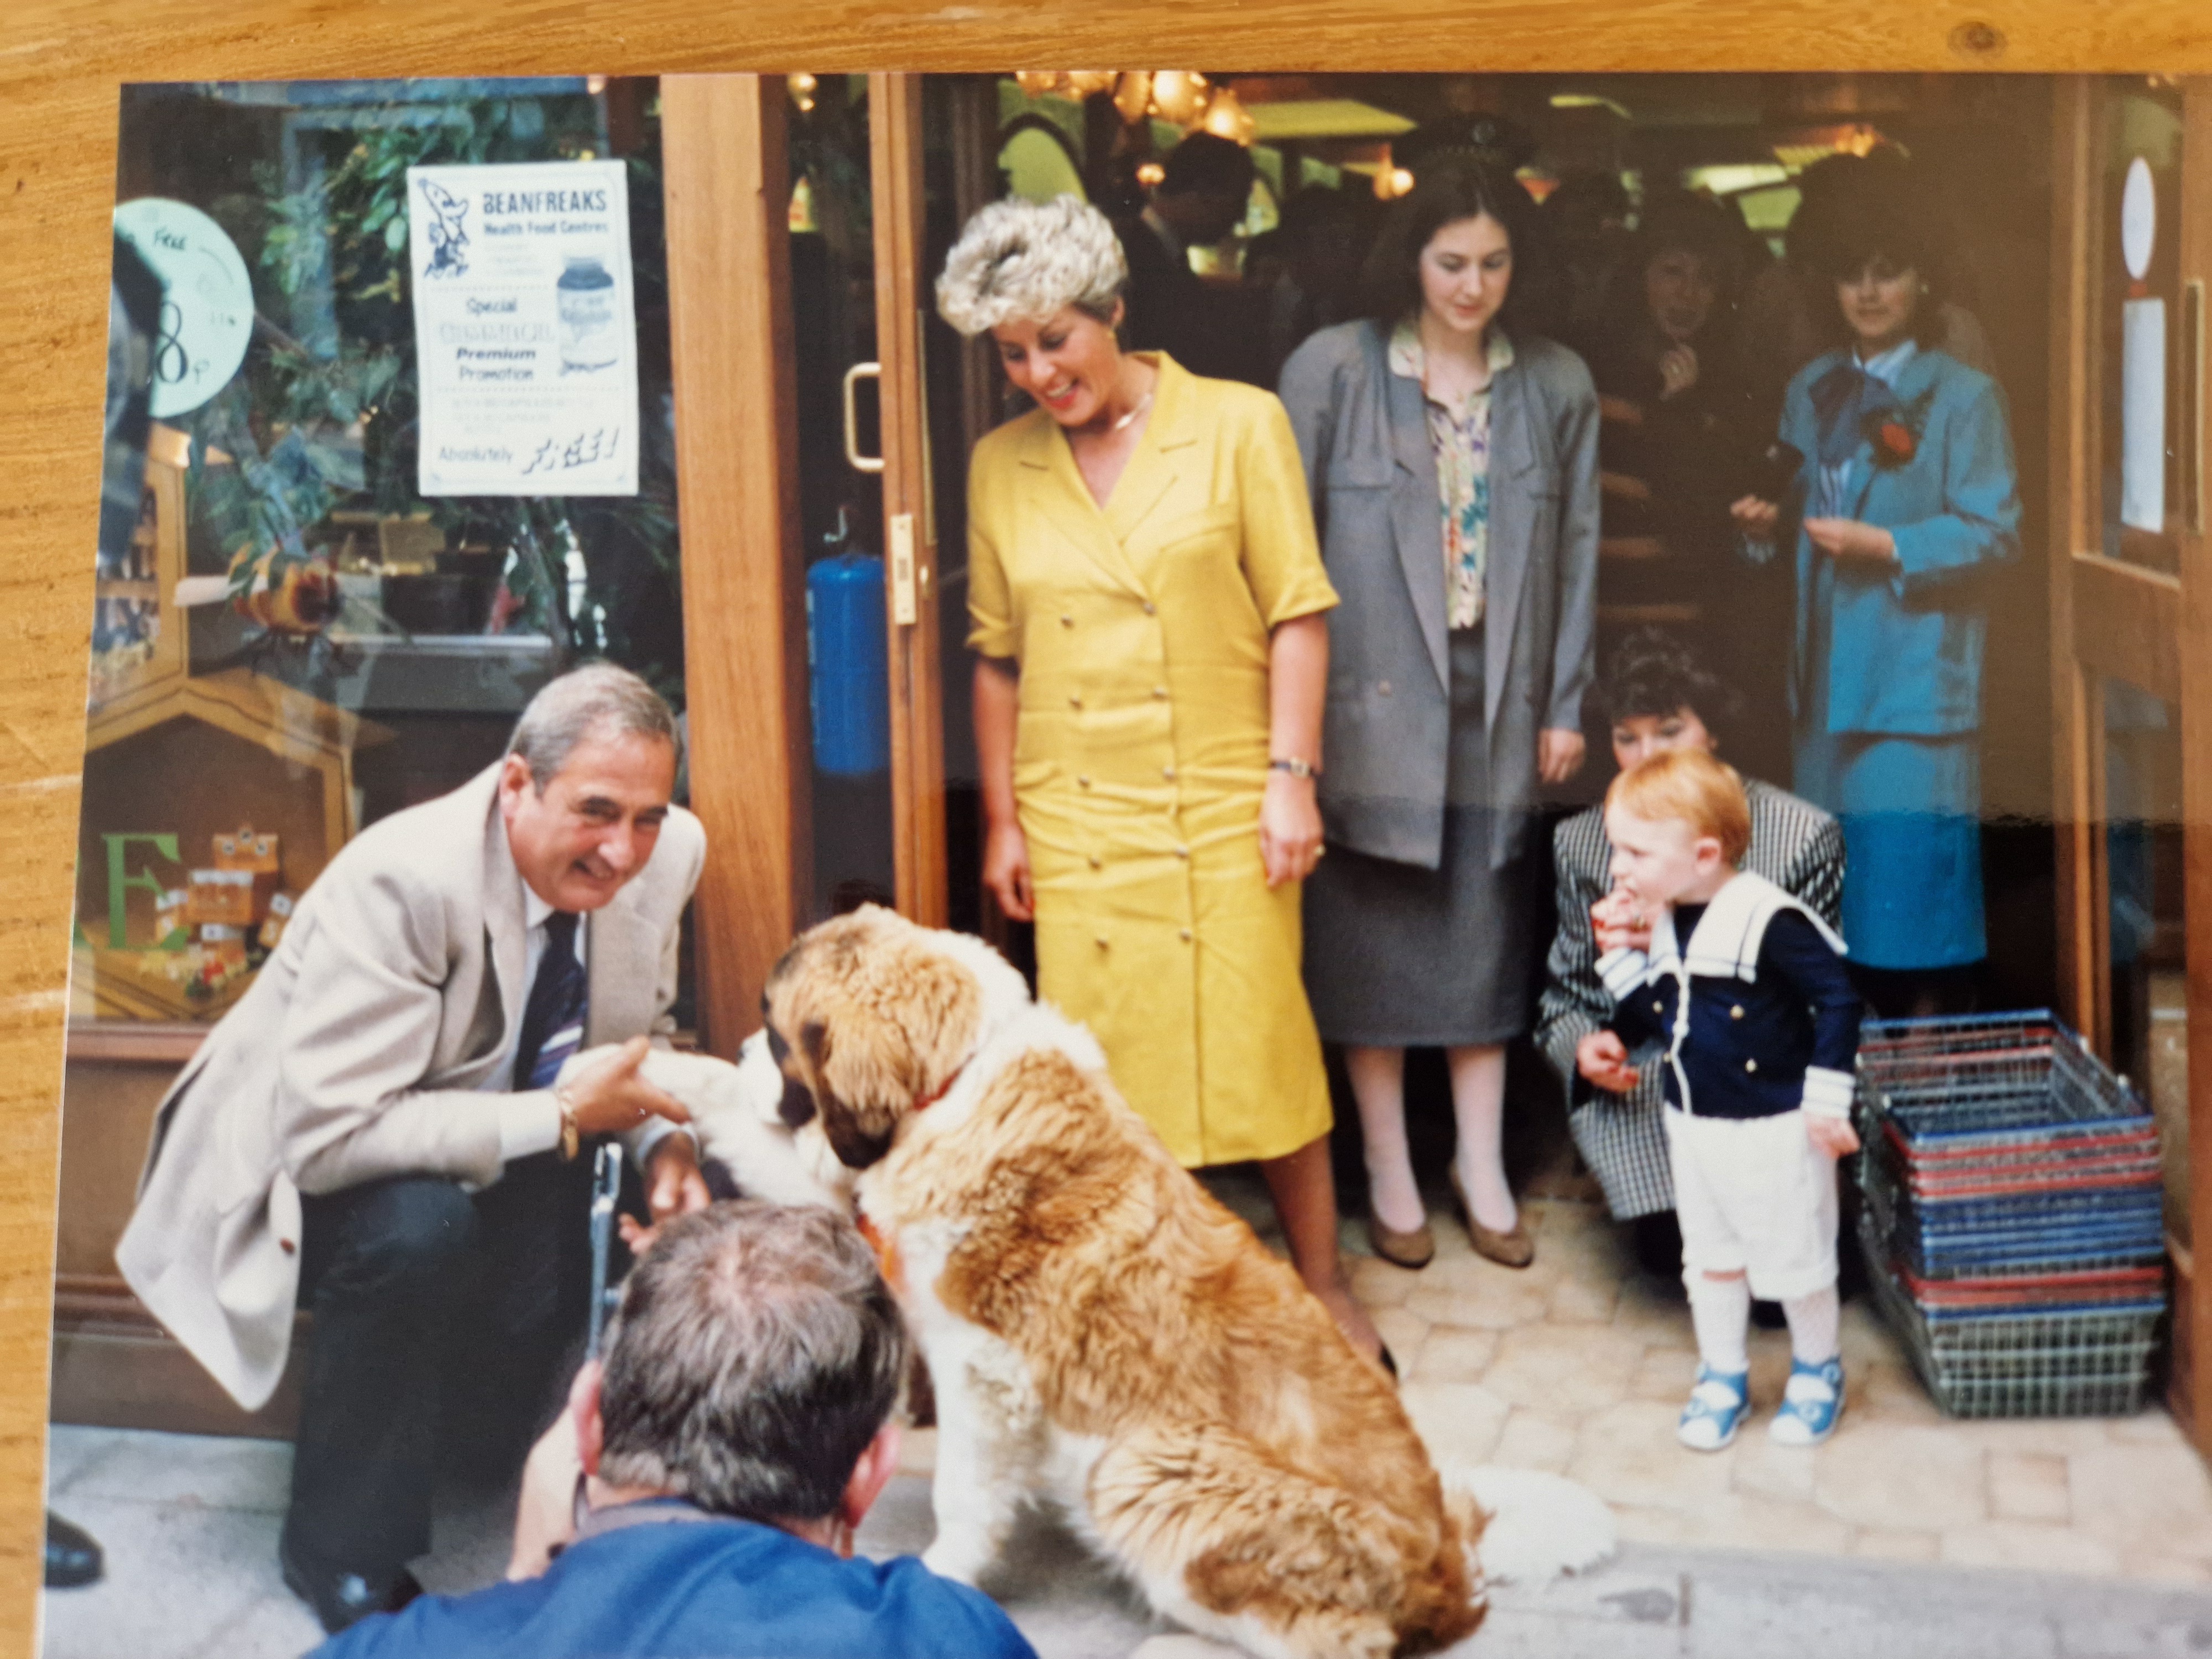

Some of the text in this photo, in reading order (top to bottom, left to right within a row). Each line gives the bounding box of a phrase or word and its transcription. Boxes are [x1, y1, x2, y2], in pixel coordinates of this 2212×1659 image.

[482, 190, 607, 215] BEANFREAKS
[466, 296, 518, 316] Special
[456, 346, 536, 361] Premium
[458, 365, 534, 382] Promotion
